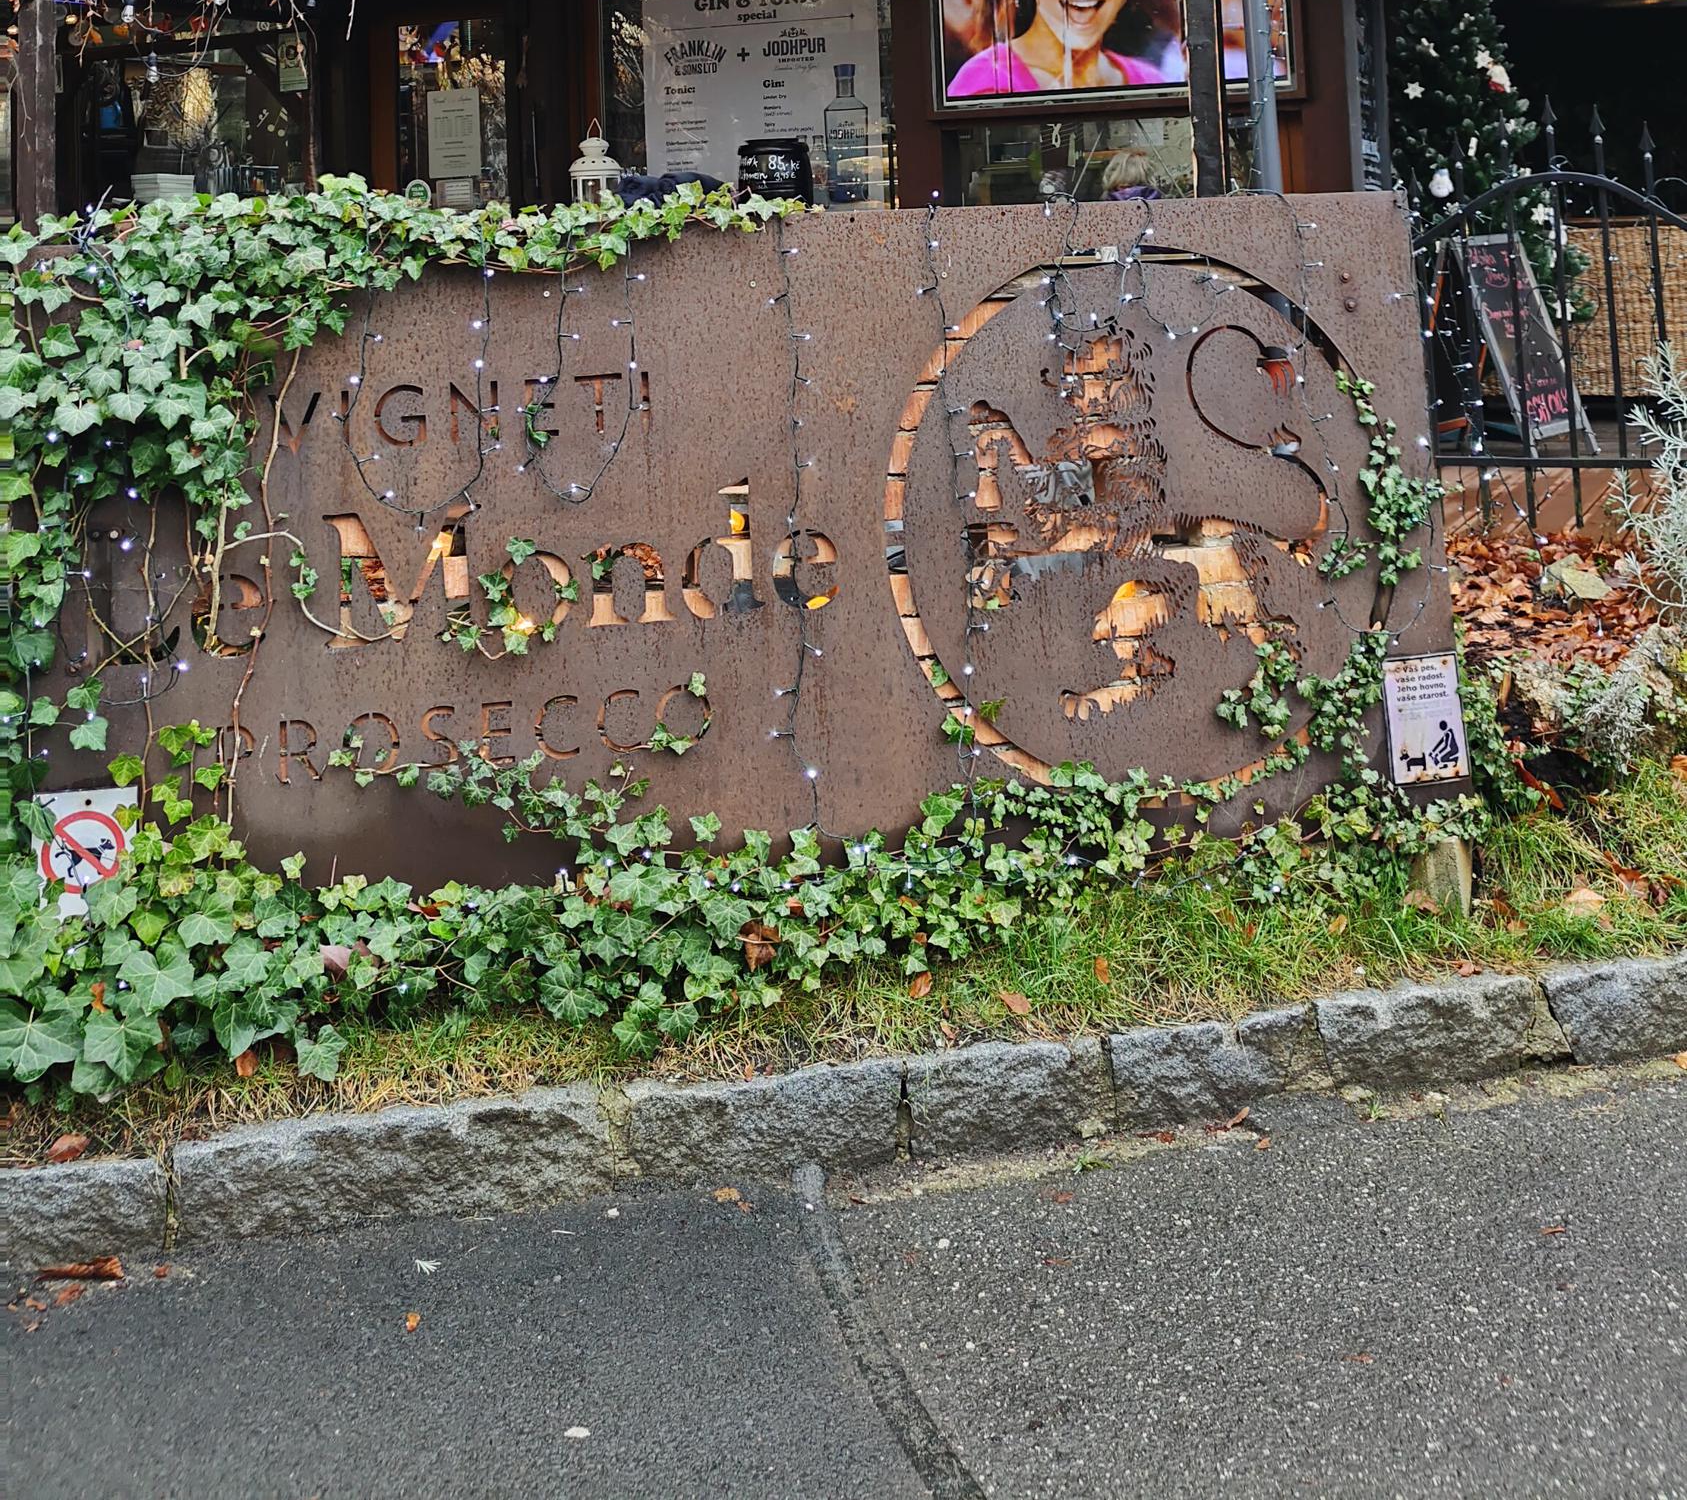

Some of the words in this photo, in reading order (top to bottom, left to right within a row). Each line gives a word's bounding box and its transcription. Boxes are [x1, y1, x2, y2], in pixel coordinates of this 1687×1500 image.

[737, 9, 777, 23] special
[663, 39, 727, 67] FRANKLIN
[762, 37, 826, 57] JODHPUR
[674, 65, 681, 76] &
[682, 63, 703, 76] SONS
[703, 62, 718, 74] LTD
[664, 85, 696, 95] Tonic:
[762, 79, 785, 88] Gin:
[268, 370, 651, 456] VIGNETI
[322, 476, 840, 649] Monde
[1402, 664, 1419, 673] Váš
[1420, 664, 1437, 672] pes,
[1395, 675, 1416, 684] vaše
[1397, 685, 1417, 693] Jeho
[1396, 694, 1416, 702] vaše
[214, 683, 715, 794] PROSECCO
